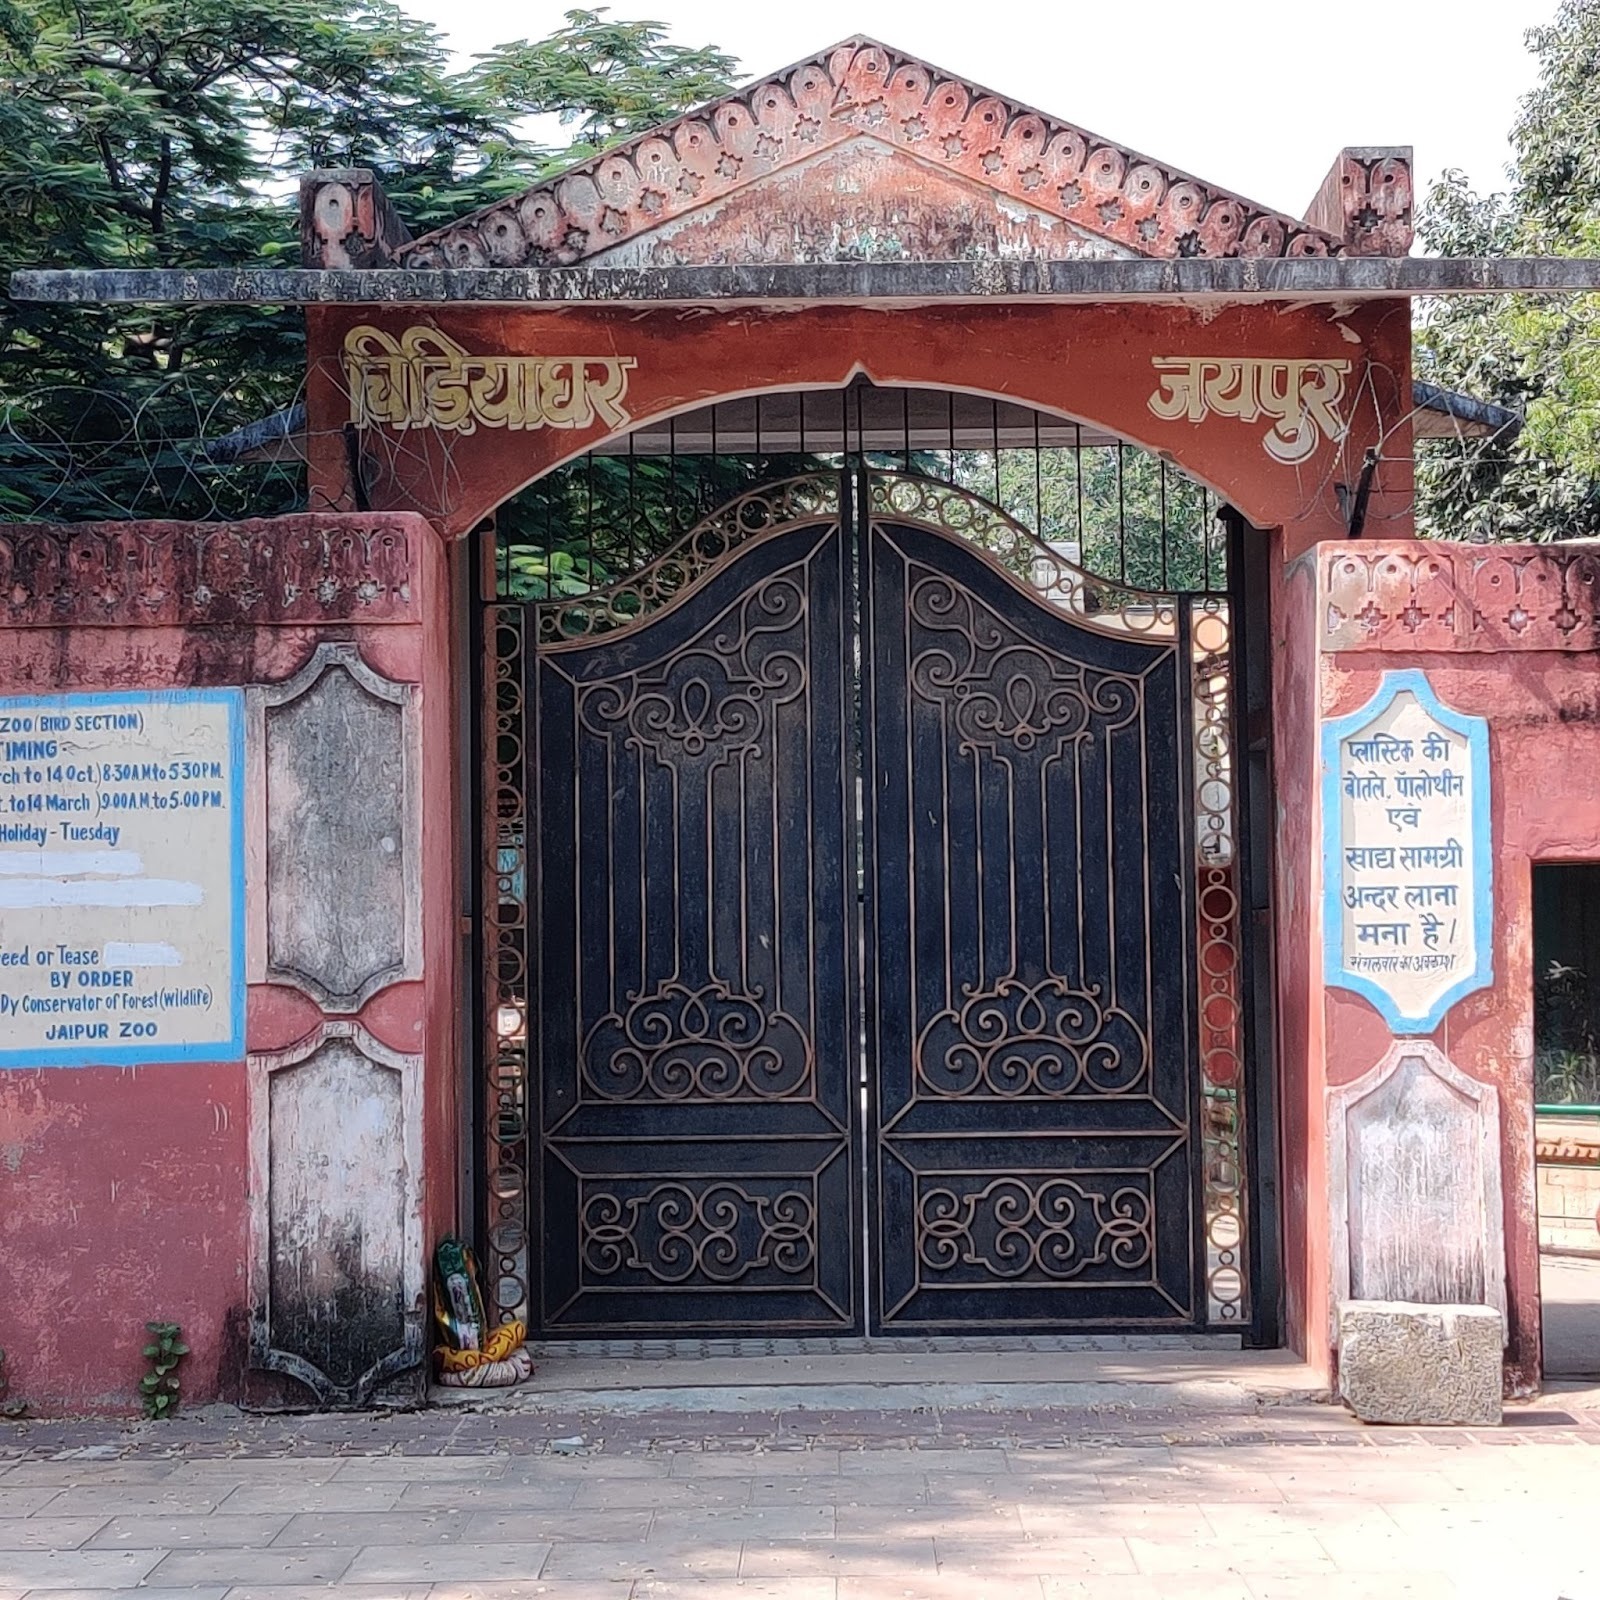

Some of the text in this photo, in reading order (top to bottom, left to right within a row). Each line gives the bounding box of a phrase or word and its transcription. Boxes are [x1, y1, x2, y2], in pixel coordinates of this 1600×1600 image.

[1147, 356, 1353, 465] जयपुर
[75, 709, 144, 736] SECTION)
[1347, 732, 1451, 764] प्लास्टिक की
[25, 766, 41, 783] to
[1385, 803, 1422, 833] एवं
[60, 821, 120, 846] Tuesday
[1345, 837, 1464, 872] खाद्य सामग्री
[1343, 885, 1458, 912] अन्दर लाना
[1356, 923, 1411, 946] मना
[36, 951, 55, 966] or
[56, 944, 99, 966] Tease
[51, 970, 133, 989] BY ORDER
[22, 994, 103, 1013] Conservator
[105, 993, 120, 1010] of
[46, 1022, 158, 1040] JAIPUR ZOO
